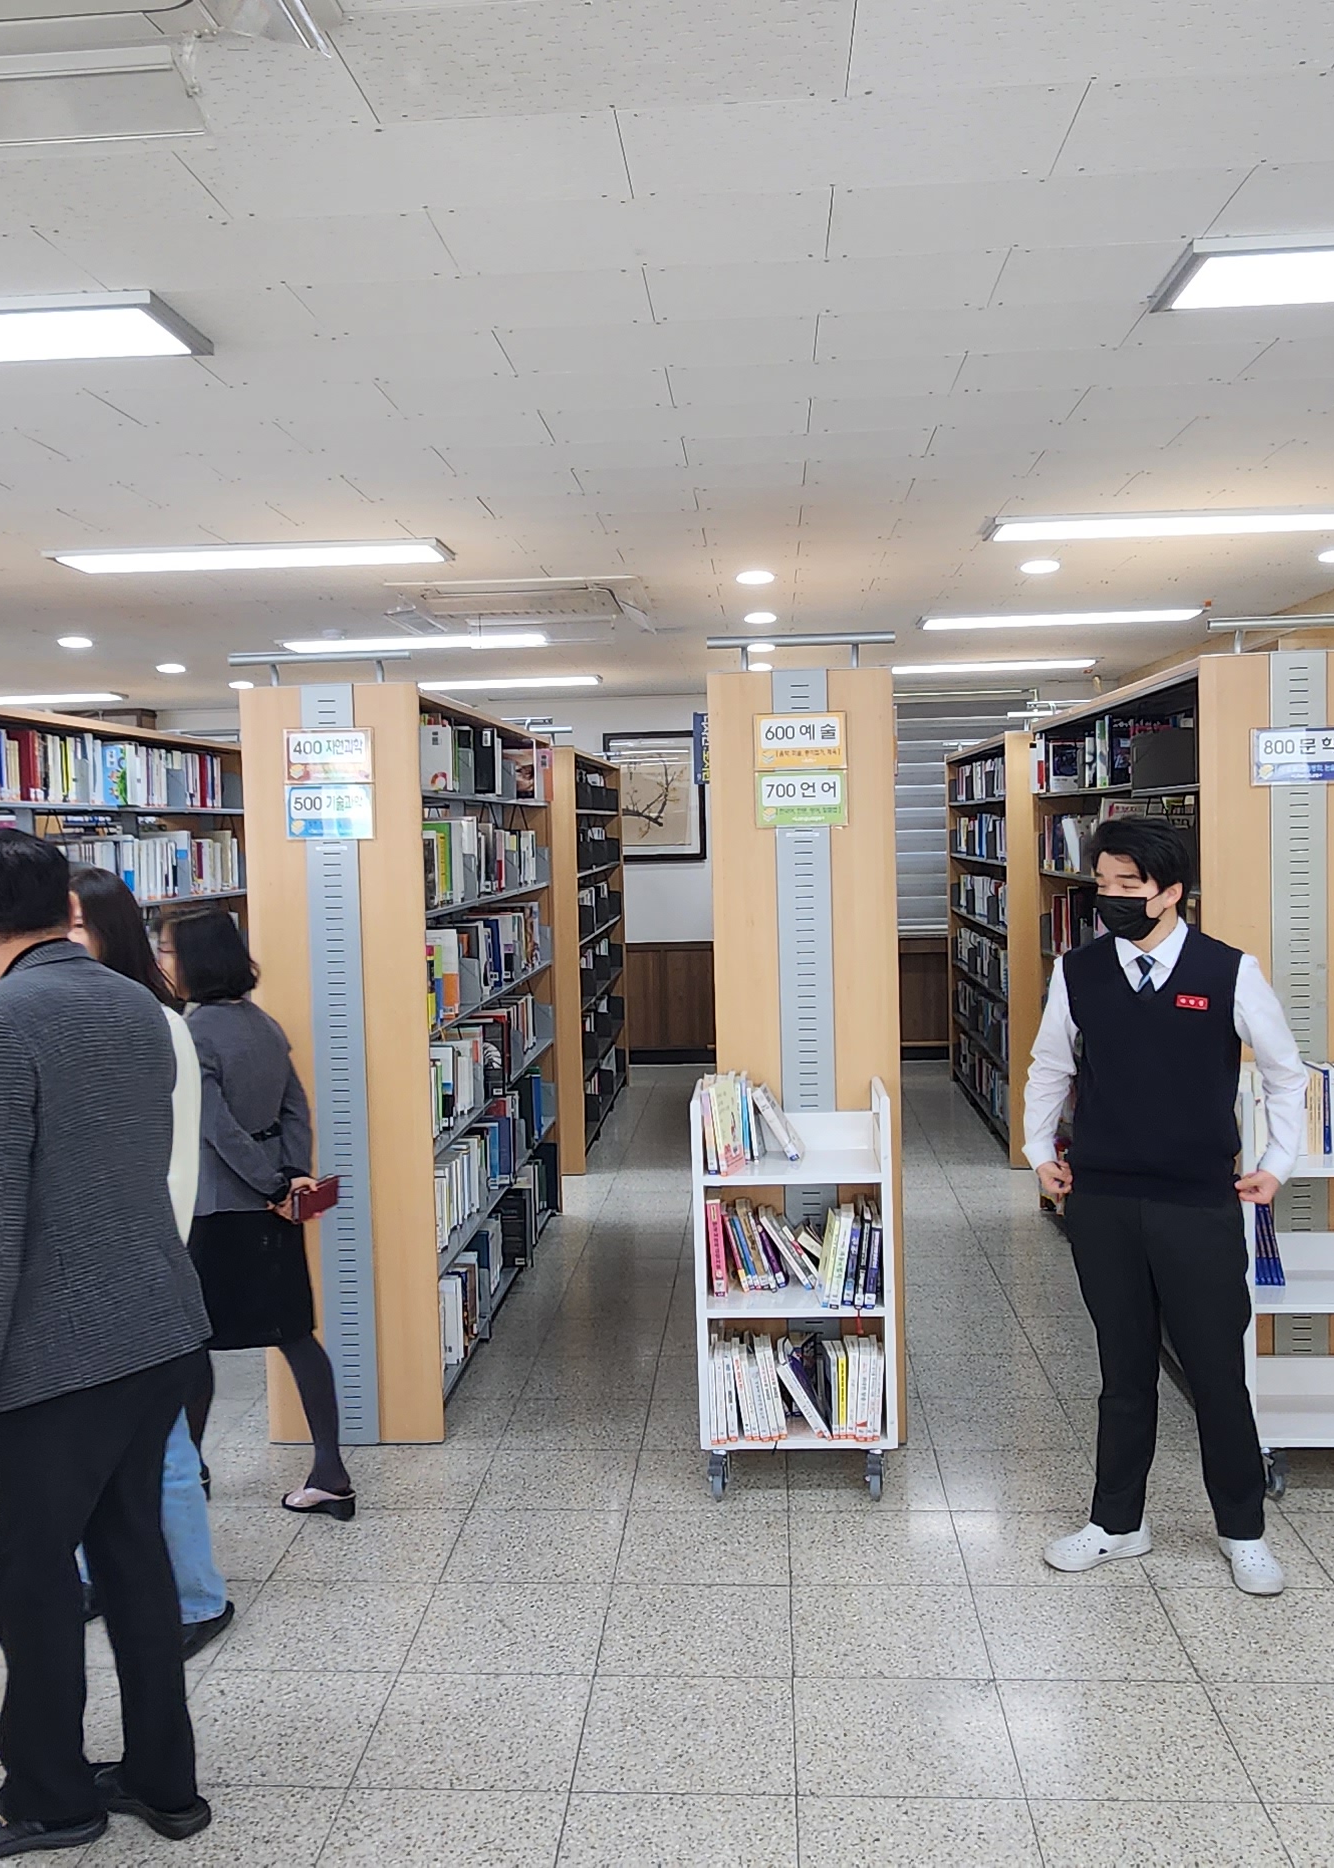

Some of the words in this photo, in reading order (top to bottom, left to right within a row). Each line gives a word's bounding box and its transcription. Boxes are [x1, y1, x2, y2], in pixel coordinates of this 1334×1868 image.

[765, 725, 795, 741] 600
[293, 740, 323, 755] 400
[325, 738, 363, 755] 자연과학
[1264, 739, 1295, 755] 800
[765, 783, 796, 799] 700
[293, 796, 323, 811] 500
[326, 795, 363, 811] 기술과학
